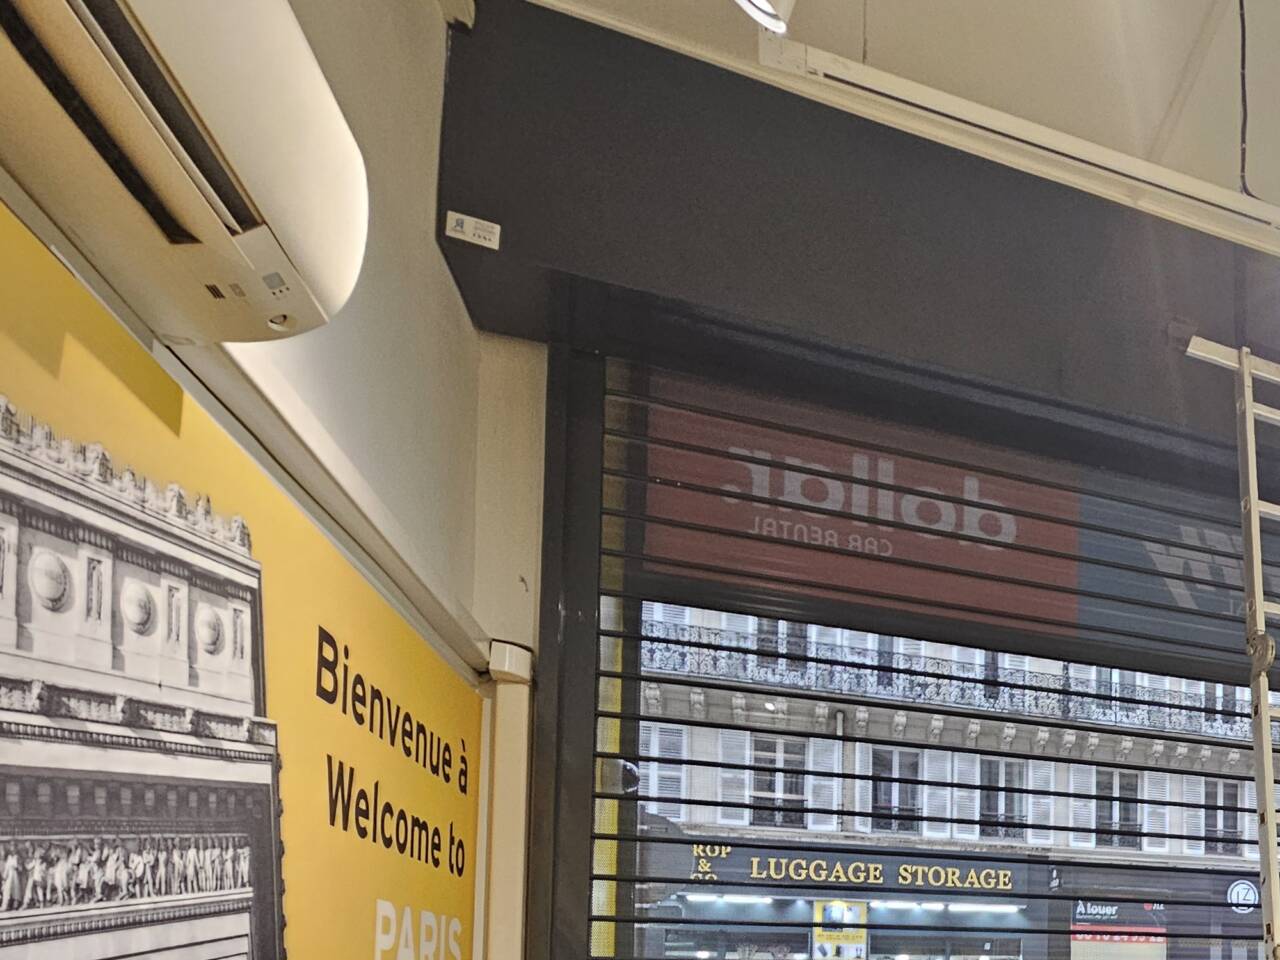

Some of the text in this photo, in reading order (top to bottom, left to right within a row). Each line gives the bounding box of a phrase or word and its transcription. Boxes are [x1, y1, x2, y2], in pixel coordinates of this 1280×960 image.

[315, 624, 468, 796] Bienvenue à
[326, 753, 466, 878] Welcome to
[698, 858, 712, 873] &
[750, 857, 1013, 890] LUGGAGE STORAGE
[1087, 902, 1118, 915] louer
